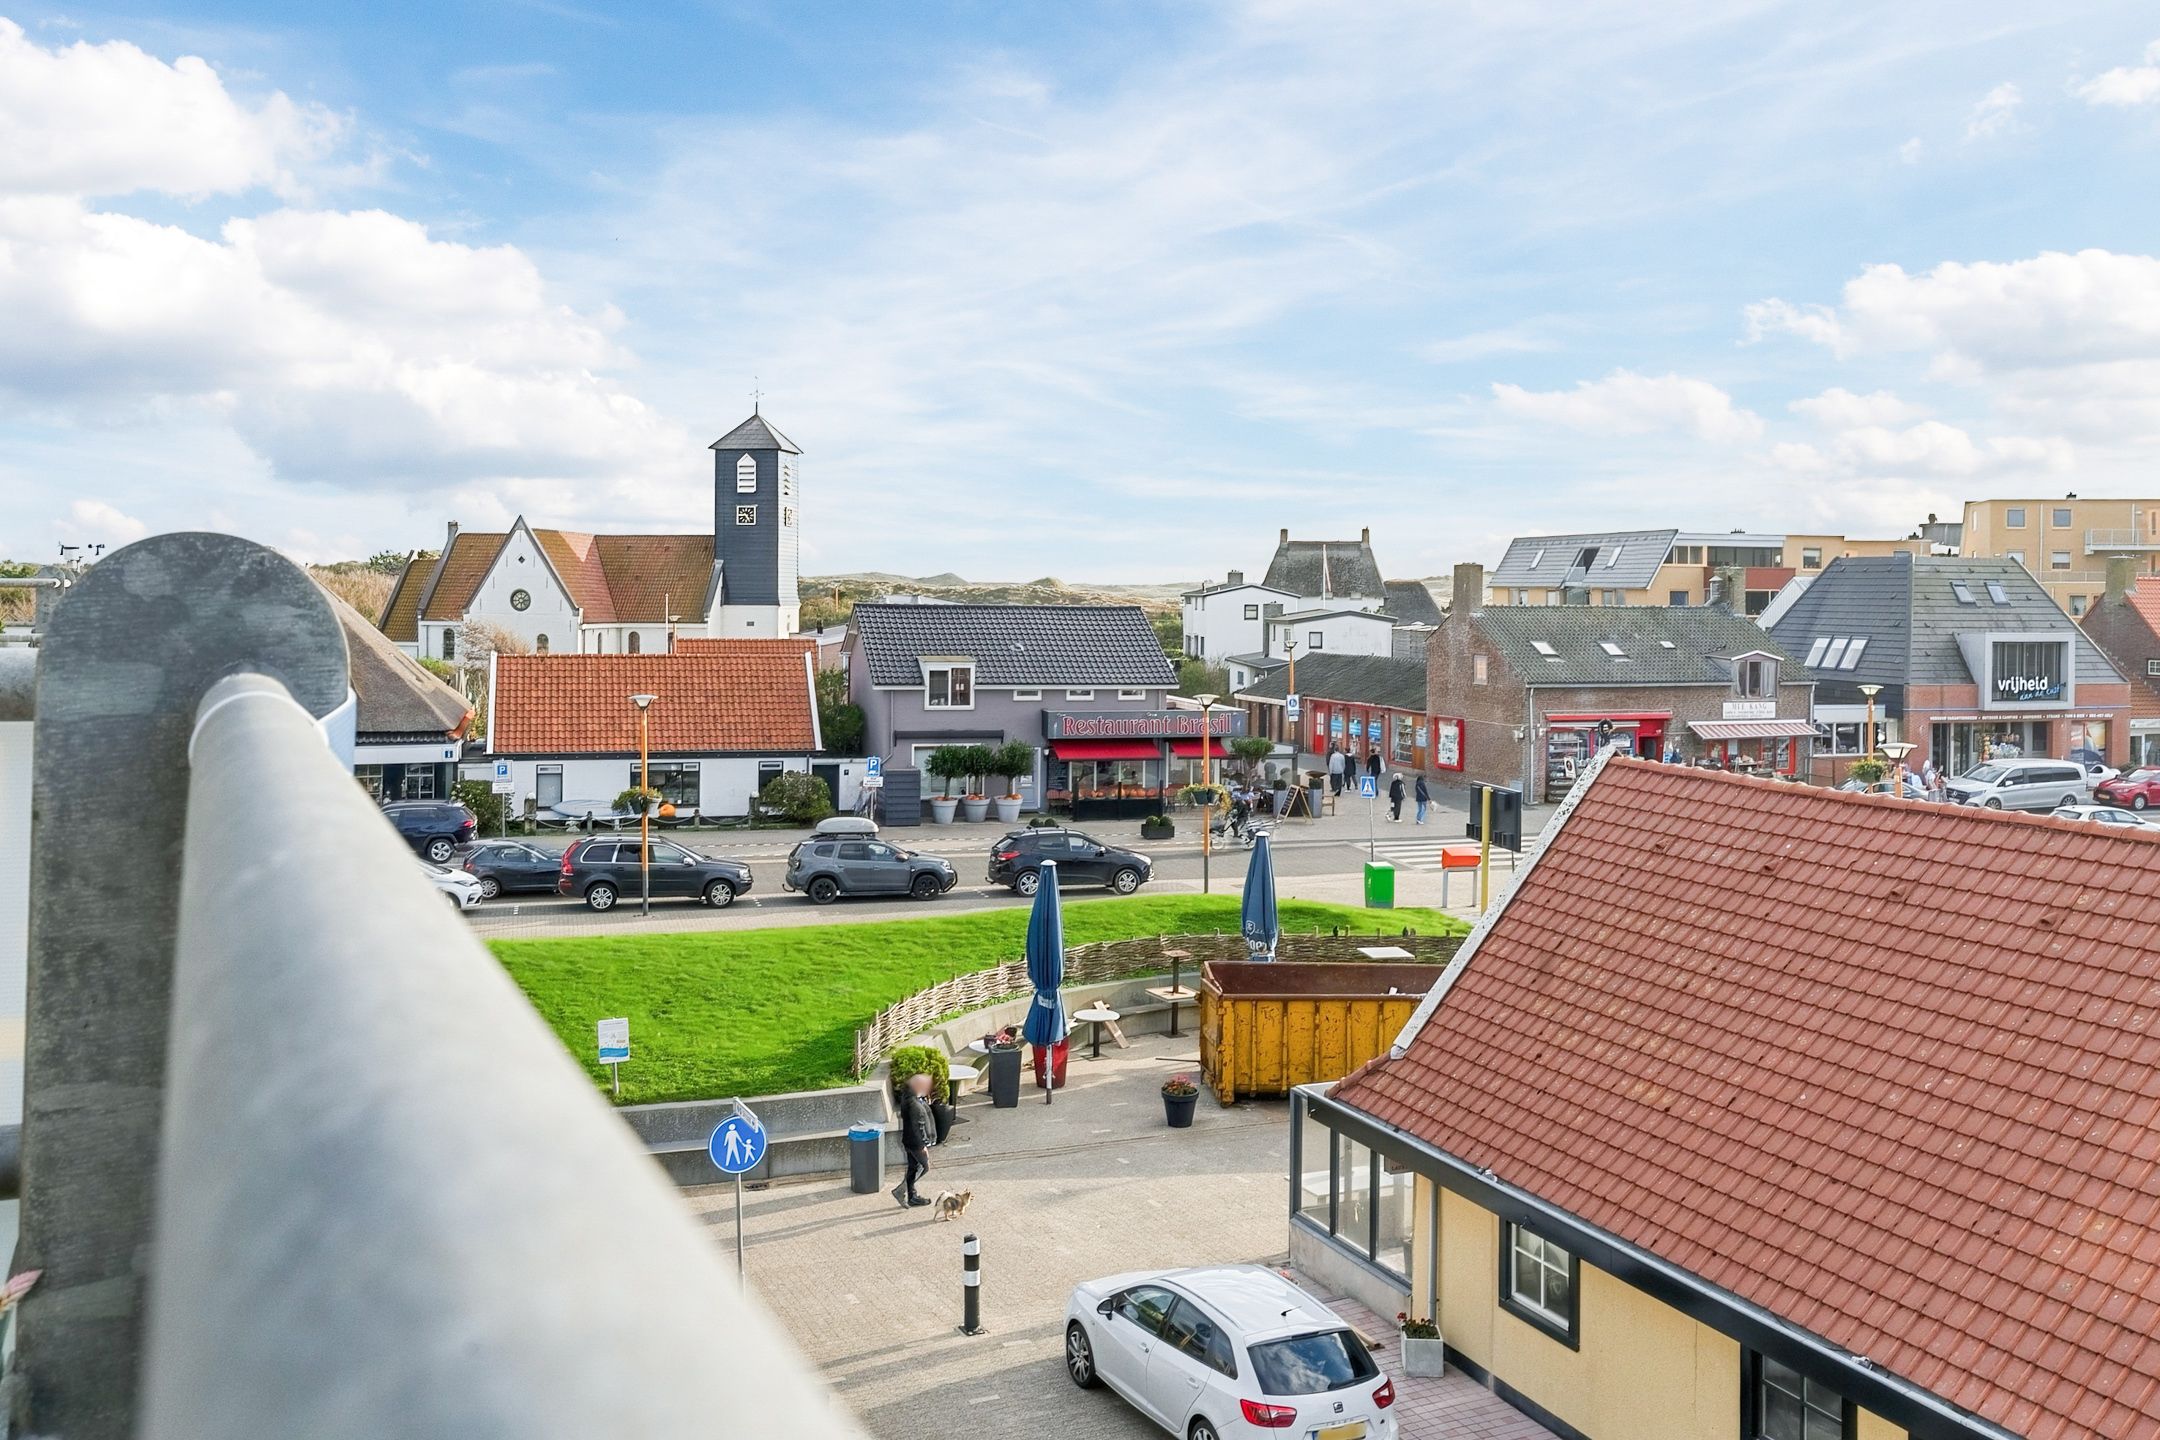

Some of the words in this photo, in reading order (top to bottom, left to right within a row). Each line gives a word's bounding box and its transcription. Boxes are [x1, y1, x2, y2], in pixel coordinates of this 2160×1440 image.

[1998, 676, 2048, 694] vrijheid
[1062, 716, 1171, 736] Restaurant
[499, 766, 506, 775] P
[870, 760, 878, 770] P
